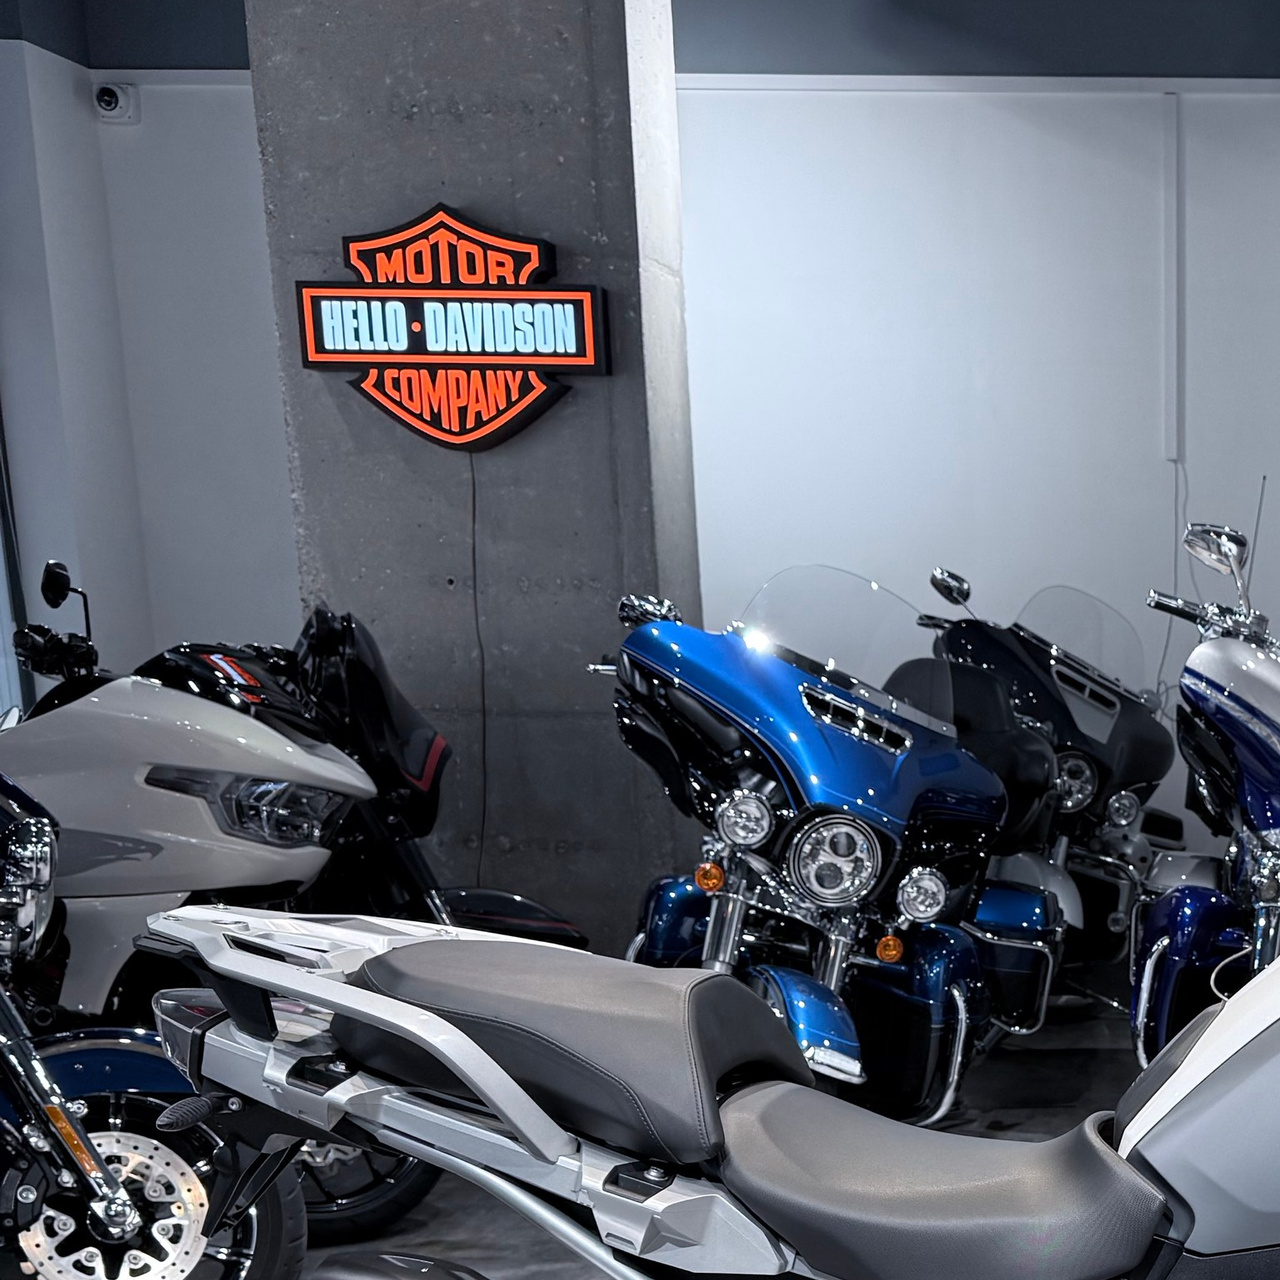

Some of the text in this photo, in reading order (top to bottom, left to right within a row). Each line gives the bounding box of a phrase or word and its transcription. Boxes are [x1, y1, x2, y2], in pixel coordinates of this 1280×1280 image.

[376, 228, 515, 284] MOTOR
[320, 301, 577, 353] HELLO DAVIDSON
[384, 368, 523, 431] COMPANY
